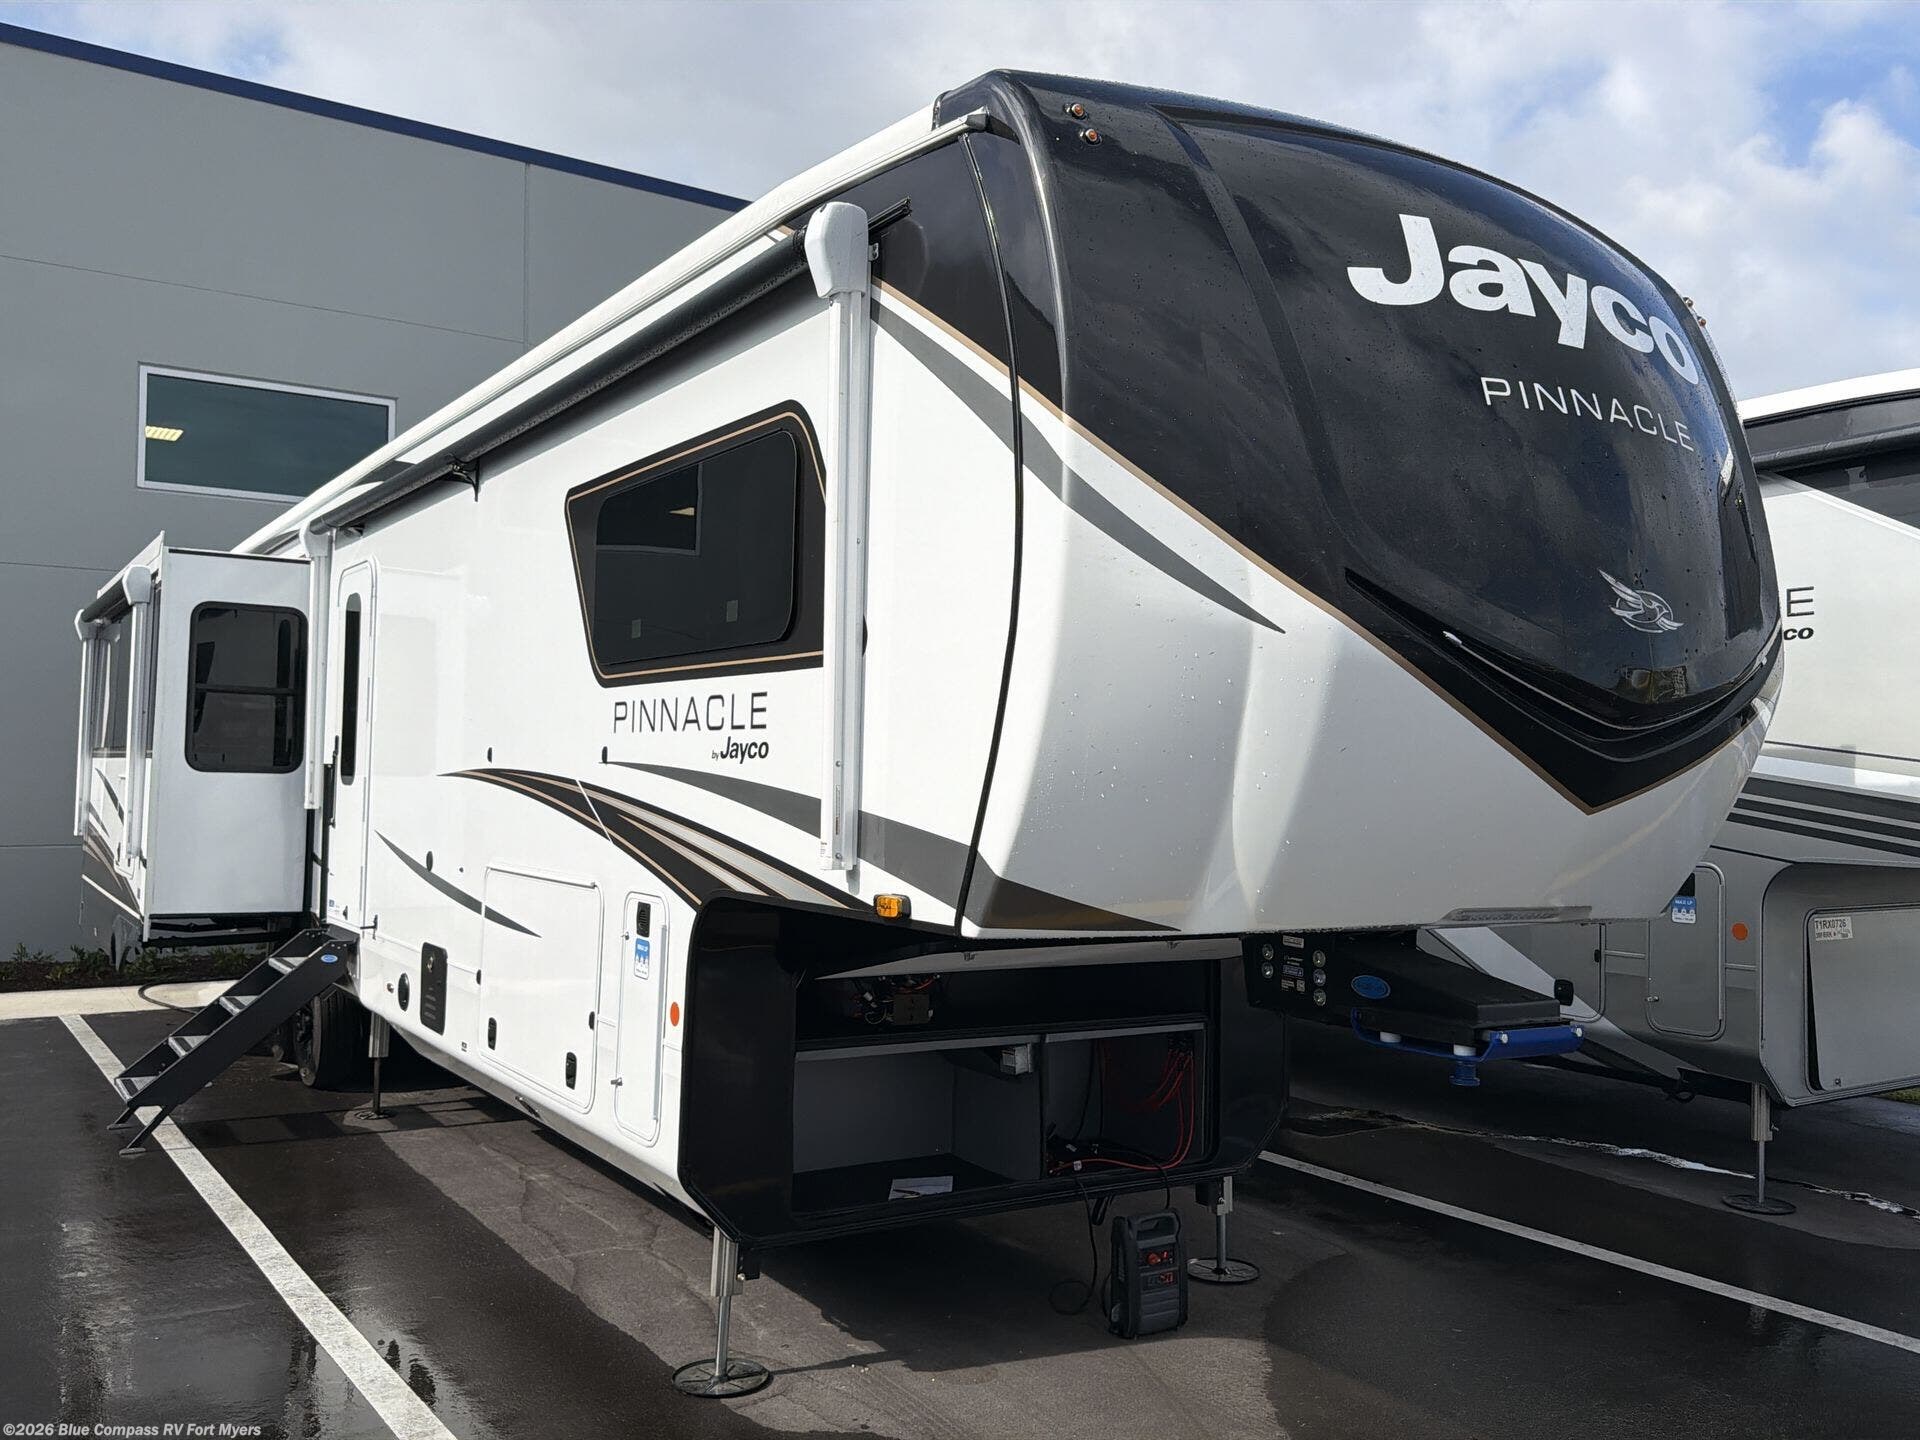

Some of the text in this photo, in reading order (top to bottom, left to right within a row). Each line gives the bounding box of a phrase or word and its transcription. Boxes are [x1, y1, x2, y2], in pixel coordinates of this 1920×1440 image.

[1347, 213, 1699, 385] Jayco
[1480, 376, 1694, 451] PINNACLE
[613, 691, 768, 733] PINNACLE
[711, 736, 769, 764] by Jayco
